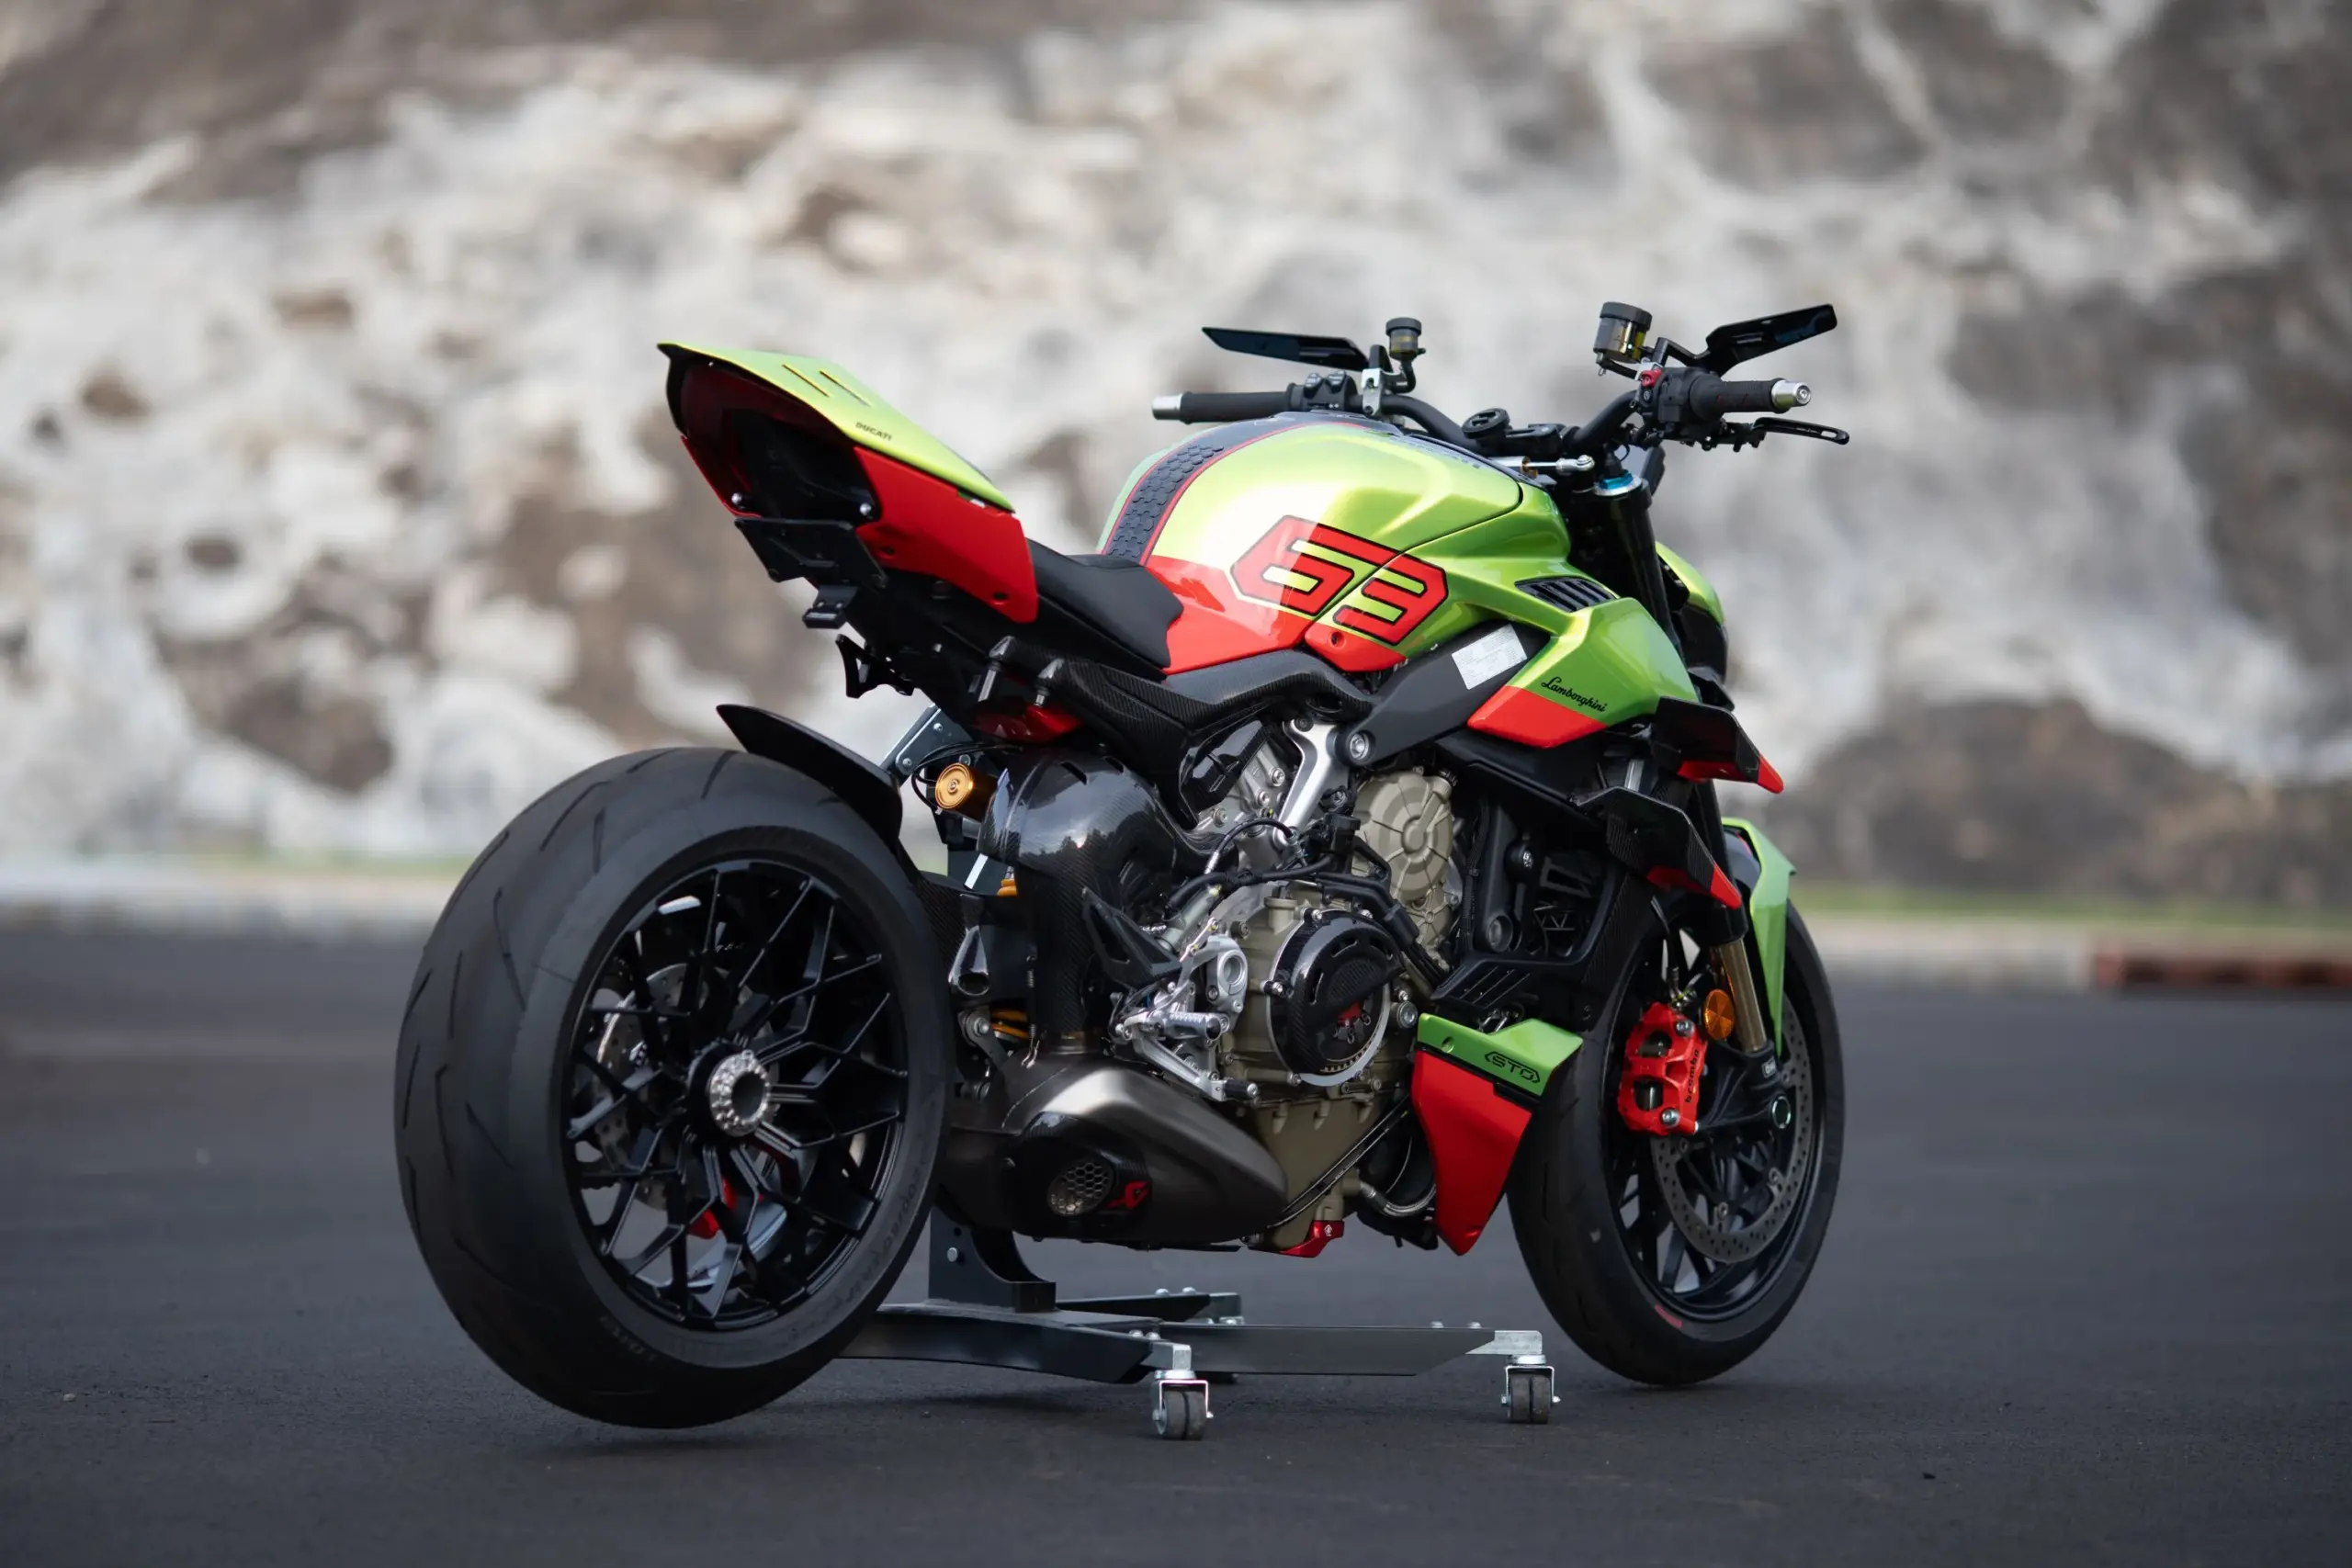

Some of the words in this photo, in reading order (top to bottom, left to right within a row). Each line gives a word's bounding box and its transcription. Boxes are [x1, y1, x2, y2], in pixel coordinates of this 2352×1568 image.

[855, 422, 892, 441] DUCATI
[1229, 514, 1449, 646] 63
[1541, 676, 1608, 712] Lamborghini
[1491, 1055, 1534, 1080] STO
[1685, 1049, 1699, 1103] brembo
